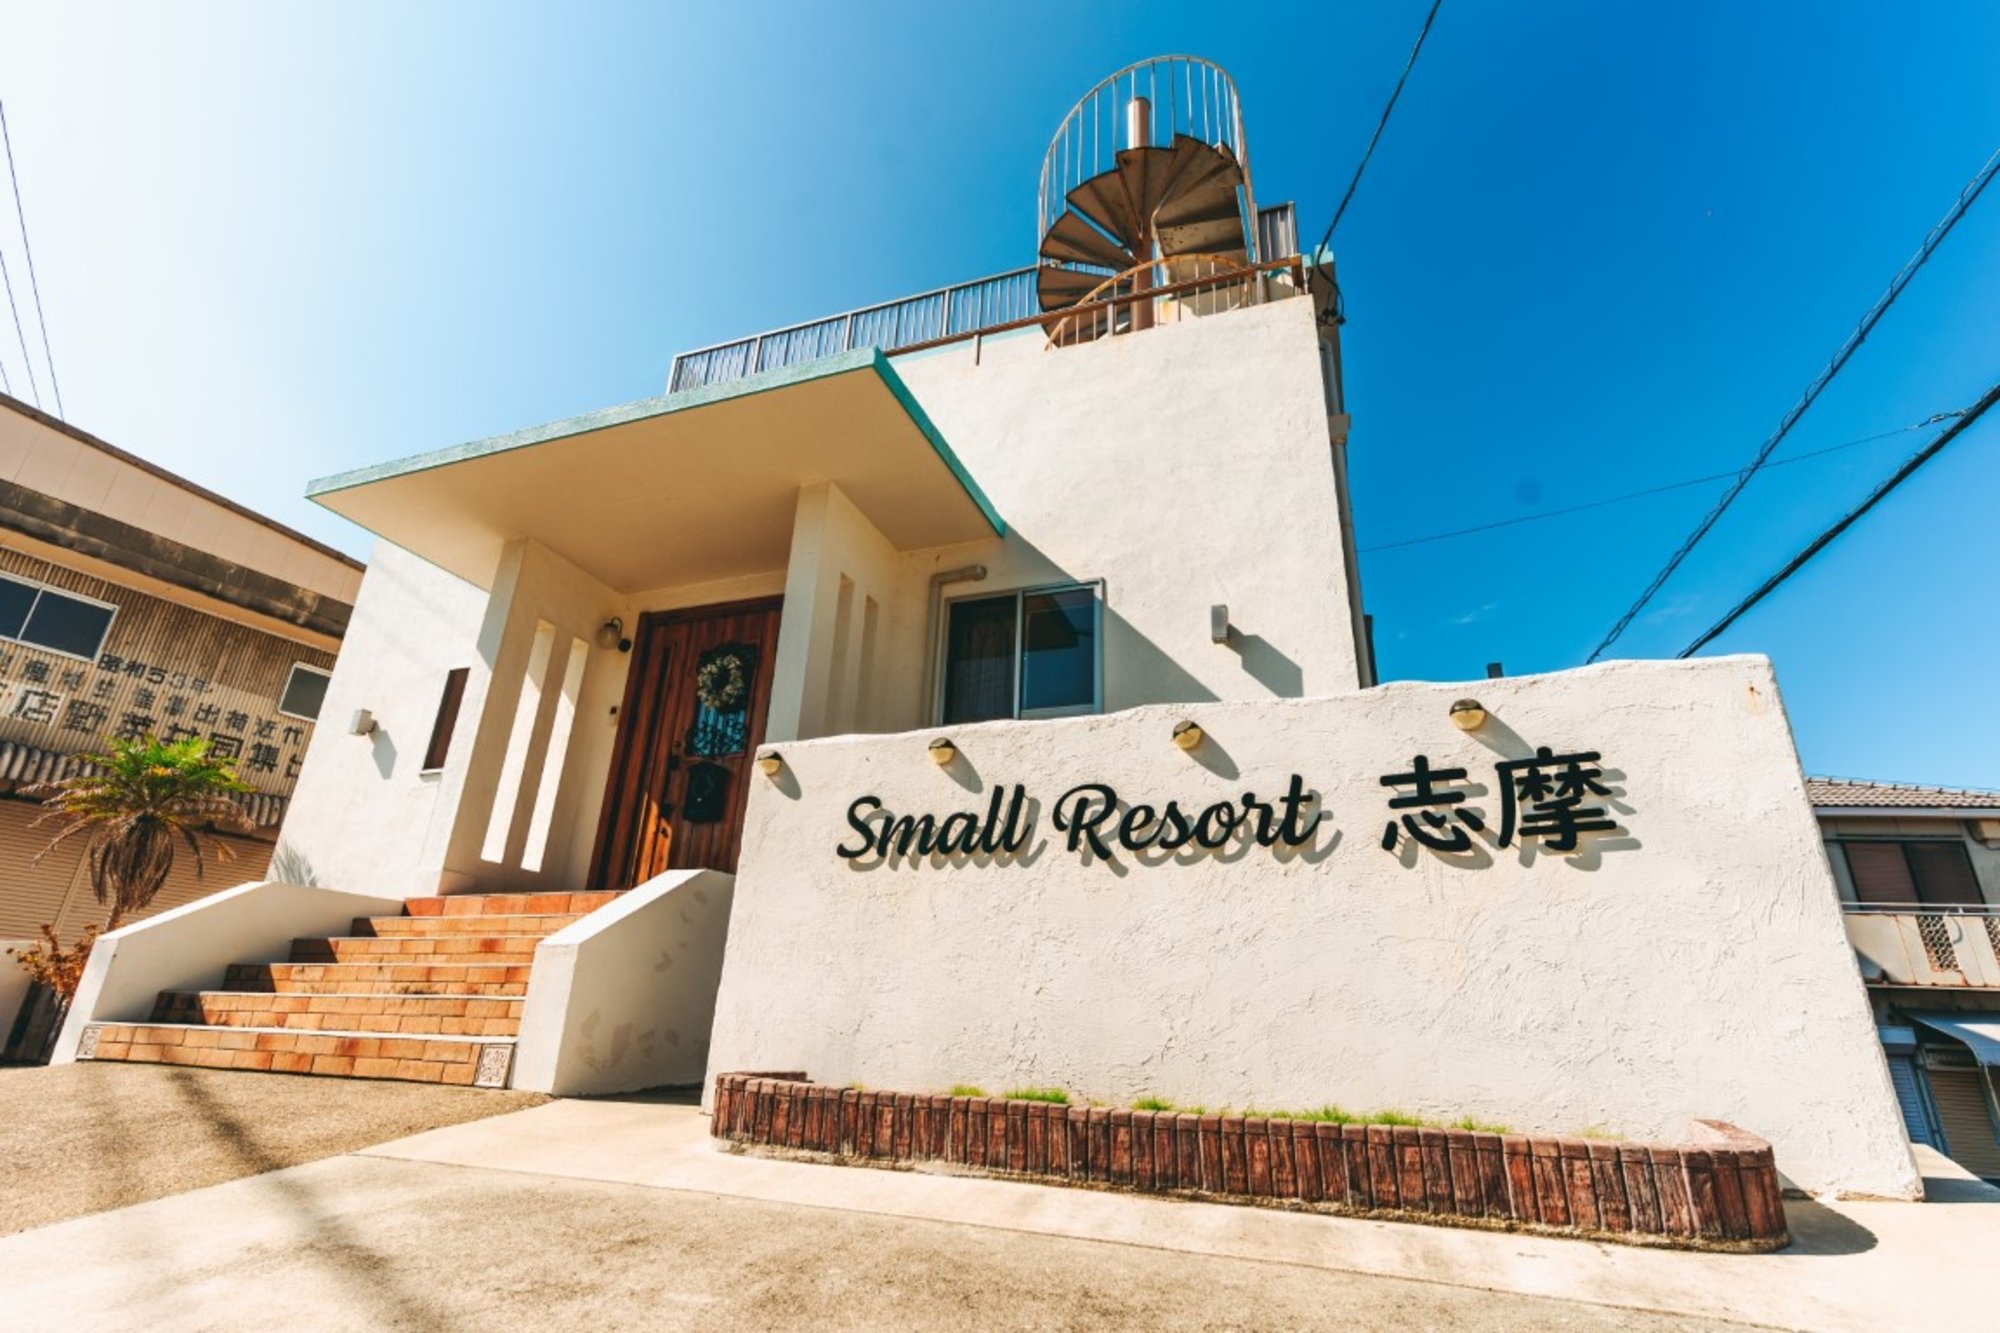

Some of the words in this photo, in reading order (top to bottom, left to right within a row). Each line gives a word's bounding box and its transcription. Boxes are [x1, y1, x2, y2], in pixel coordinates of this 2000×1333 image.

[836, 784, 1031, 859] Small
[1052, 773, 1322, 861] Resort
[1380, 746, 1618, 853] 志摩
